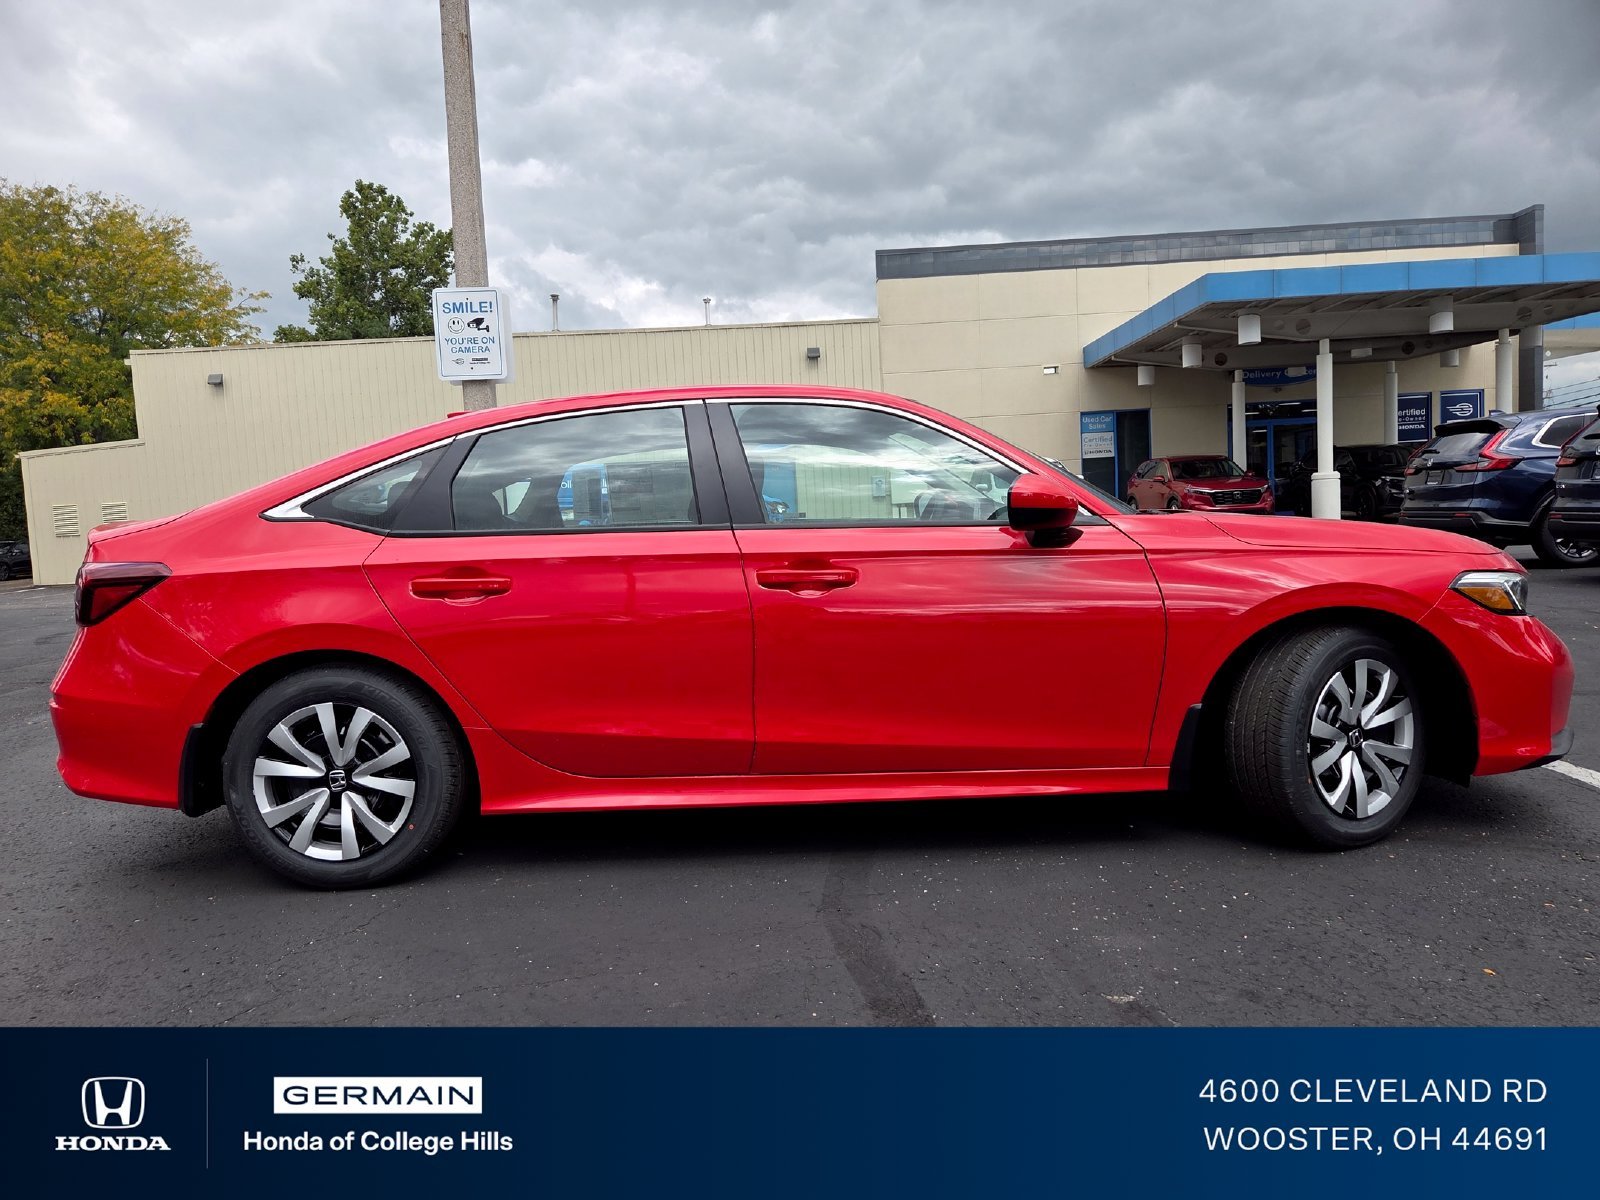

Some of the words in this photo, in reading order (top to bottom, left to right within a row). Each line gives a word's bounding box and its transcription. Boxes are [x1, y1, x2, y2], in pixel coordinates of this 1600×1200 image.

[442, 301, 493, 314] SMILE!
[445, 336, 479, 345] YOU'RE
[481, 336, 495, 344] ON
[451, 345, 490, 354] CAMERA
[1242, 370, 1282, 379] Delivery
[1398, 408, 1426, 416] ertified
[1083, 435, 1113, 443] Certified
